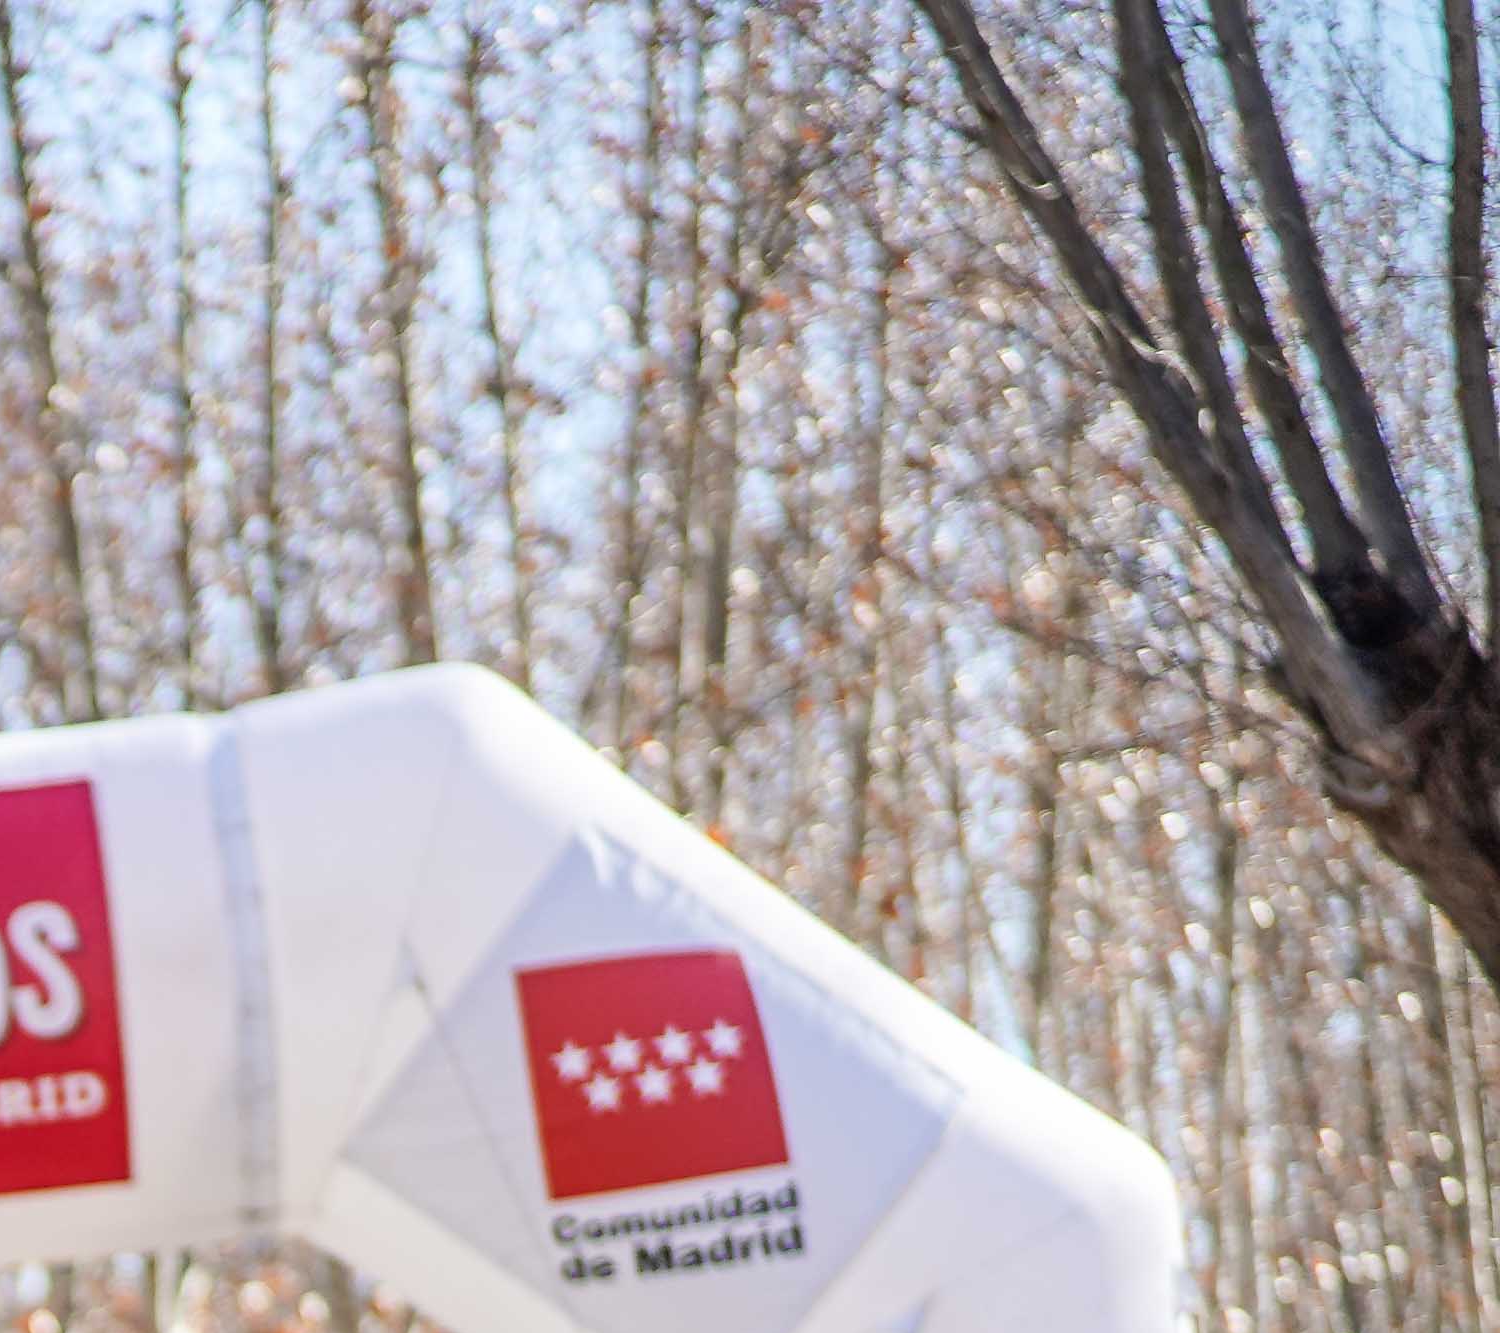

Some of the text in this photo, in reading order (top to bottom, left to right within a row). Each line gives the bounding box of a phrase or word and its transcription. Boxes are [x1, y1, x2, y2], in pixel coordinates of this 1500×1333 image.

[550, 1180, 801, 1244] Comunidad
[560, 1223, 806, 1282] de Madrid
